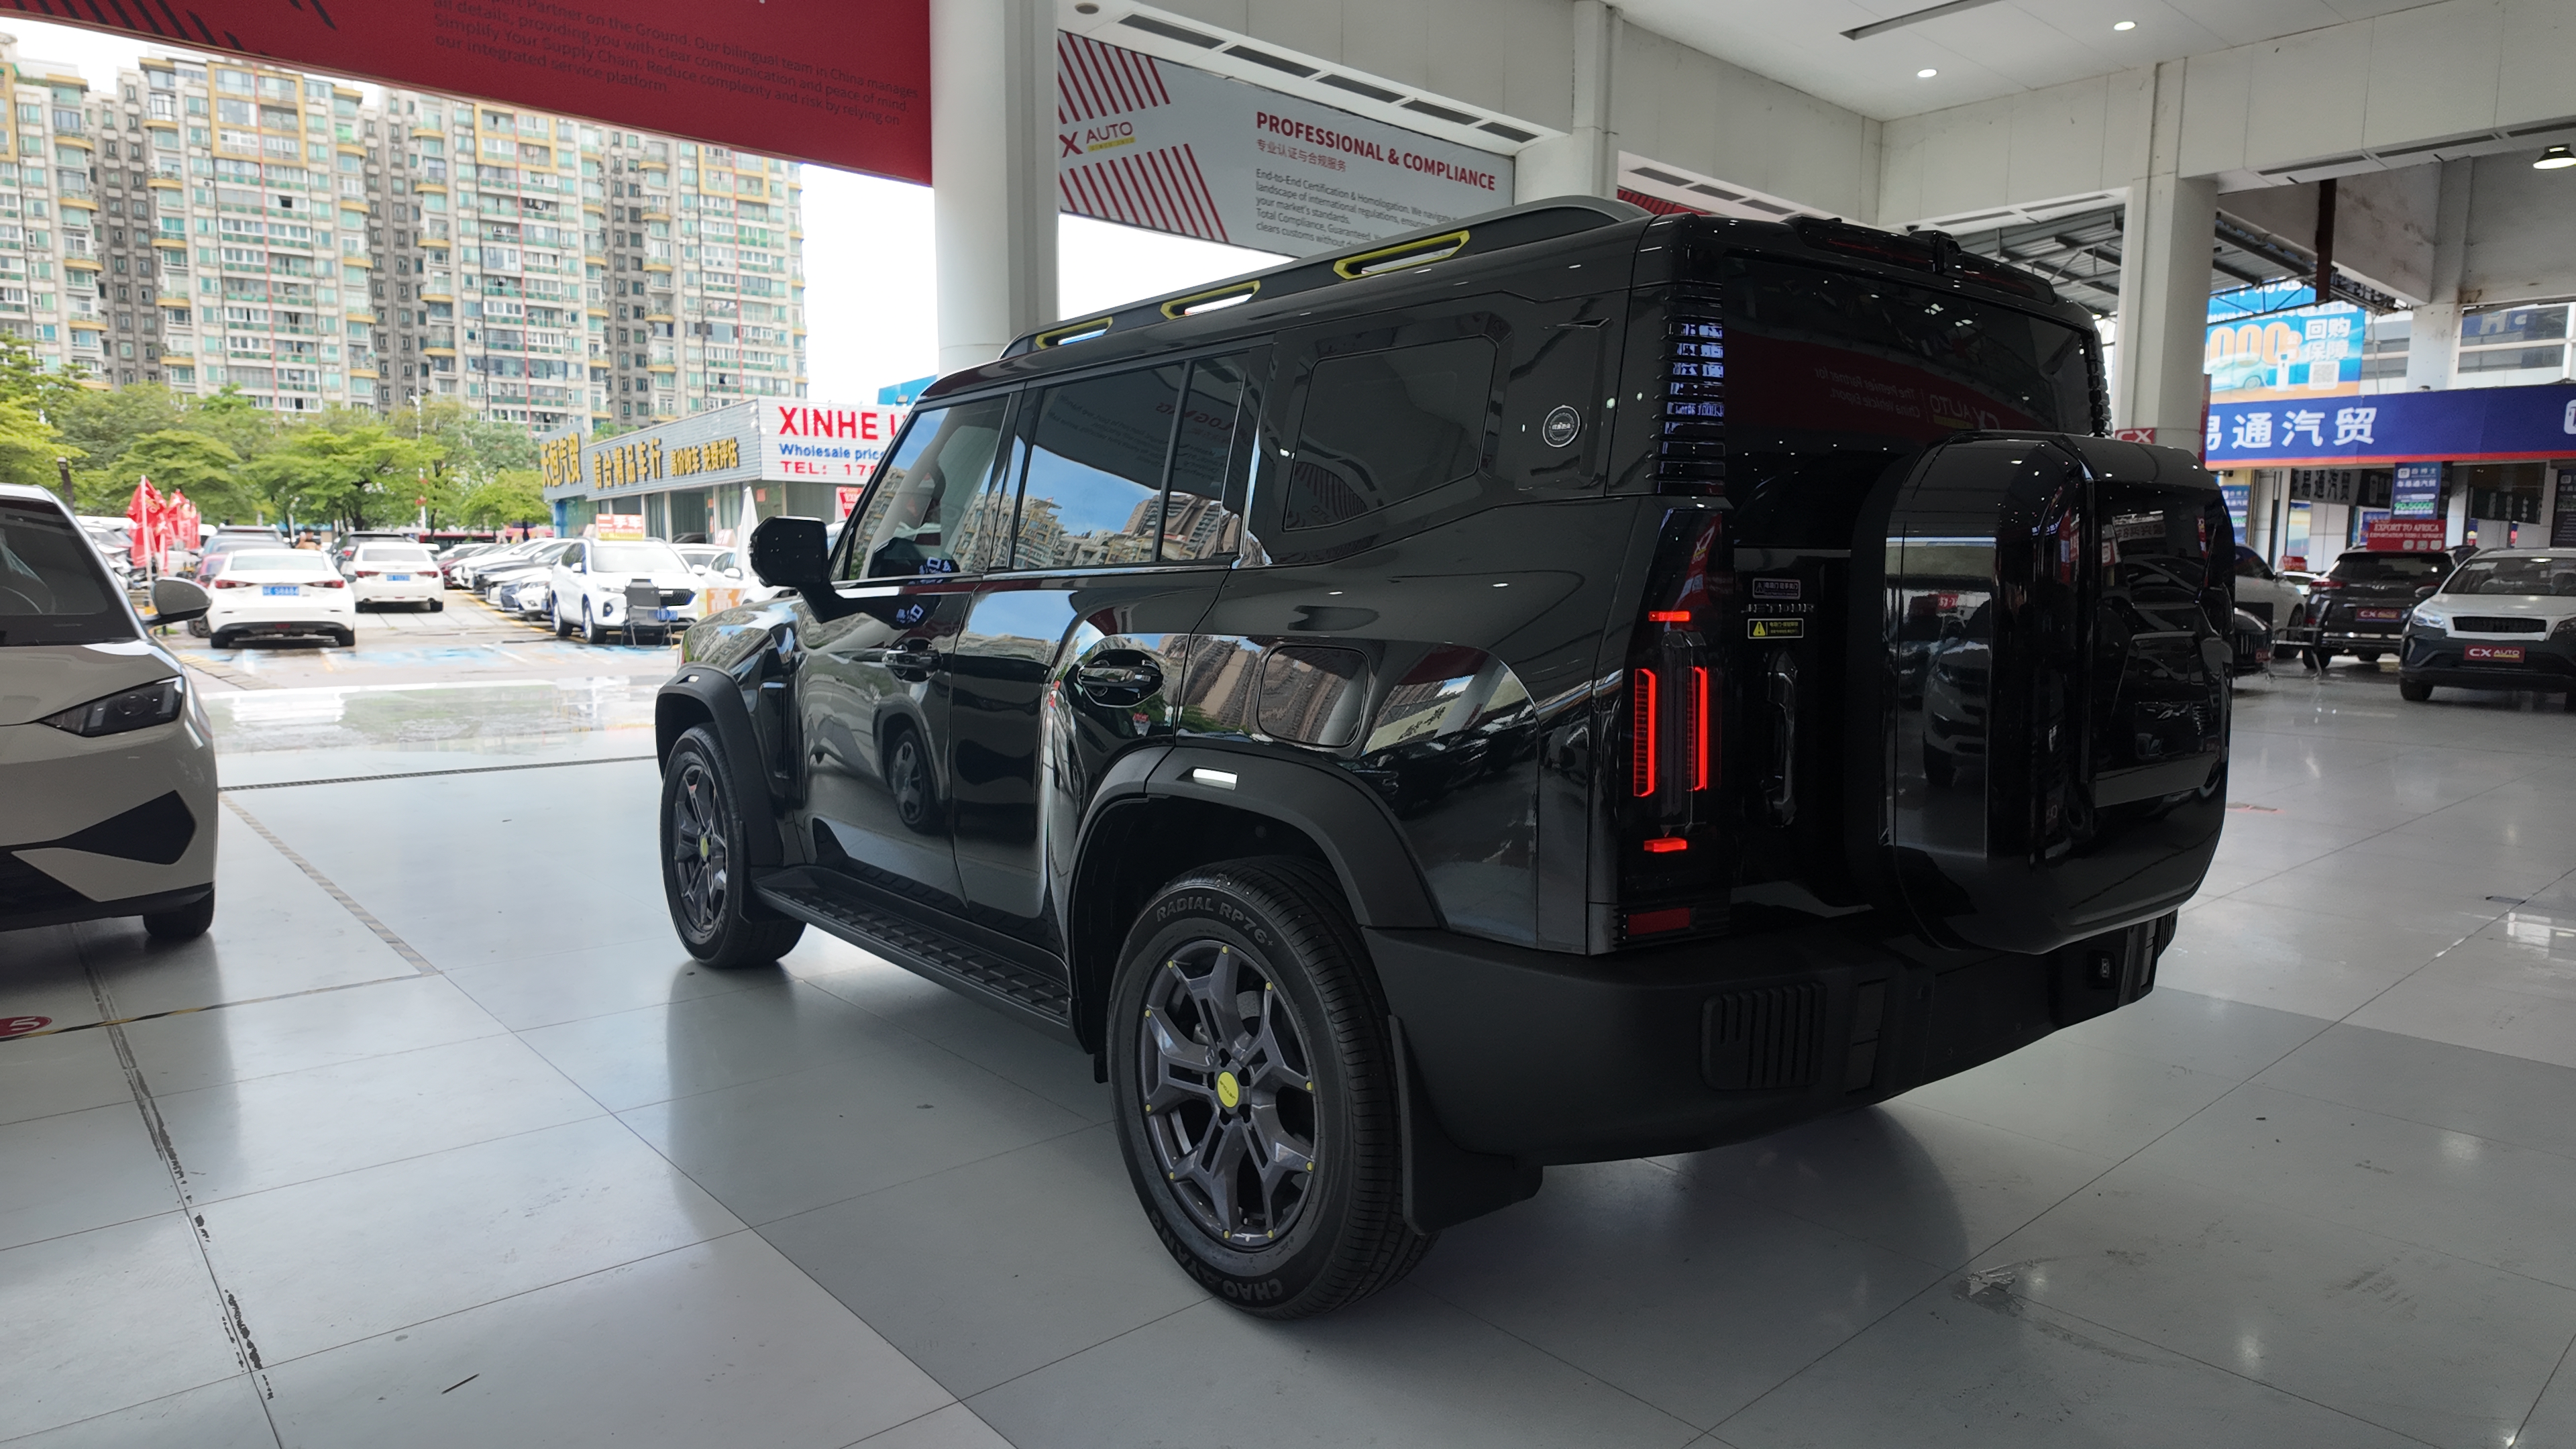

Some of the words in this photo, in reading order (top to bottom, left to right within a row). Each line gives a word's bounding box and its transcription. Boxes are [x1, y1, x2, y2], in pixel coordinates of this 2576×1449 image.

[435, 34, 462, 49] our
[468, 38, 547, 67] integrated
[551, 58, 602, 78] service
[519, 15, 591, 44] providing
[594, 33, 620, 48] you
[625, 39, 655, 56] with
[658, 46, 690, 63] clear
[694, 56, 796, 87] communication
[800, 77, 822, 93] and
[826, 85, 860, 101] peace
[863, 92, 875, 103] of
[877, 96, 909, 112] mind.
[587, 14, 604, 26] on
[609, 15, 631, 32] the
[635, 22, 691, 47] Ground.
[695, 36, 720, 52] Our
[723, 42, 779, 66] bilingual
[782, 58, 812, 74] team
[816, 66, 828, 77] in
[830, 68, 865, 86] China
[867, 78, 918, 99] manages
[435, 13, 498, 41] Simplify
[505, 30, 537, 47] Your
[543, 39, 594, 62] Supply
[598, 50, 643, 70] Chain.
[647, 60, 696, 81] Reduce
[700, 74, 771, 99] complexity
[775, 90, 797, 103] and
[802, 96, 822, 109] risk
[826, 101, 840, 114] by
[843, 105, 883, 125] relying
[885, 115, 900, 126] on
[1086, 121, 1133, 144] AUTO
[1256, 111, 1384, 162] PROFESSIONAL
[1387, 147, 1399, 166] &
[1403, 152, 1496, 191] COMPLIANCE
[1256, 138, 1346, 172] 专业认证与合规服务
[1256, 168, 1302, 187] End-to-End
[1303, 180, 1349, 199] Certification
[1351, 190, 1356, 201] &
[1358, 193, 1410, 214] Homologation.
[1411, 206, 1422, 217] We
[1423, 209, 1451, 223] navigate
[1256, 181, 1297, 201] landscape
[1299, 191, 1307, 201] of
[1308, 193, 1356, 213] international
[1358, 206, 1400, 225] regulations,
[1256, 196, 1275, 209] your
[1276, 200, 1311, 215] market's
[1311, 207, 1350, 225] standards.
[1256, 209, 1277, 223] Total
[1278, 213, 1326, 233] Compliance,
[1256, 222, 1280, 235] clears
[1281, 227, 1315, 242] customs
[1316, 233, 1346, 248] without
[2306, 318, 2351, 341] 回购
[2304, 340, 2349, 362] 保障
[778, 405, 879, 440] XINHE
[2116, 429, 2152, 444] CX
[779, 443, 851, 459] Wholesale
[780, 461, 828, 475] TEL:
[599, 515, 642, 529] 二手车
[2374, 523, 2402, 532] EXPORT
[2402, 523, 2412, 532] TO
[2413, 523, 2439, 532] AFRICA
[2360, 610, 2377, 618] CX
[2469, 648, 2491, 657] CX
[1157, 896, 1214, 922] RADIAL
[1222, 1278, 1284, 1301] CHAO
